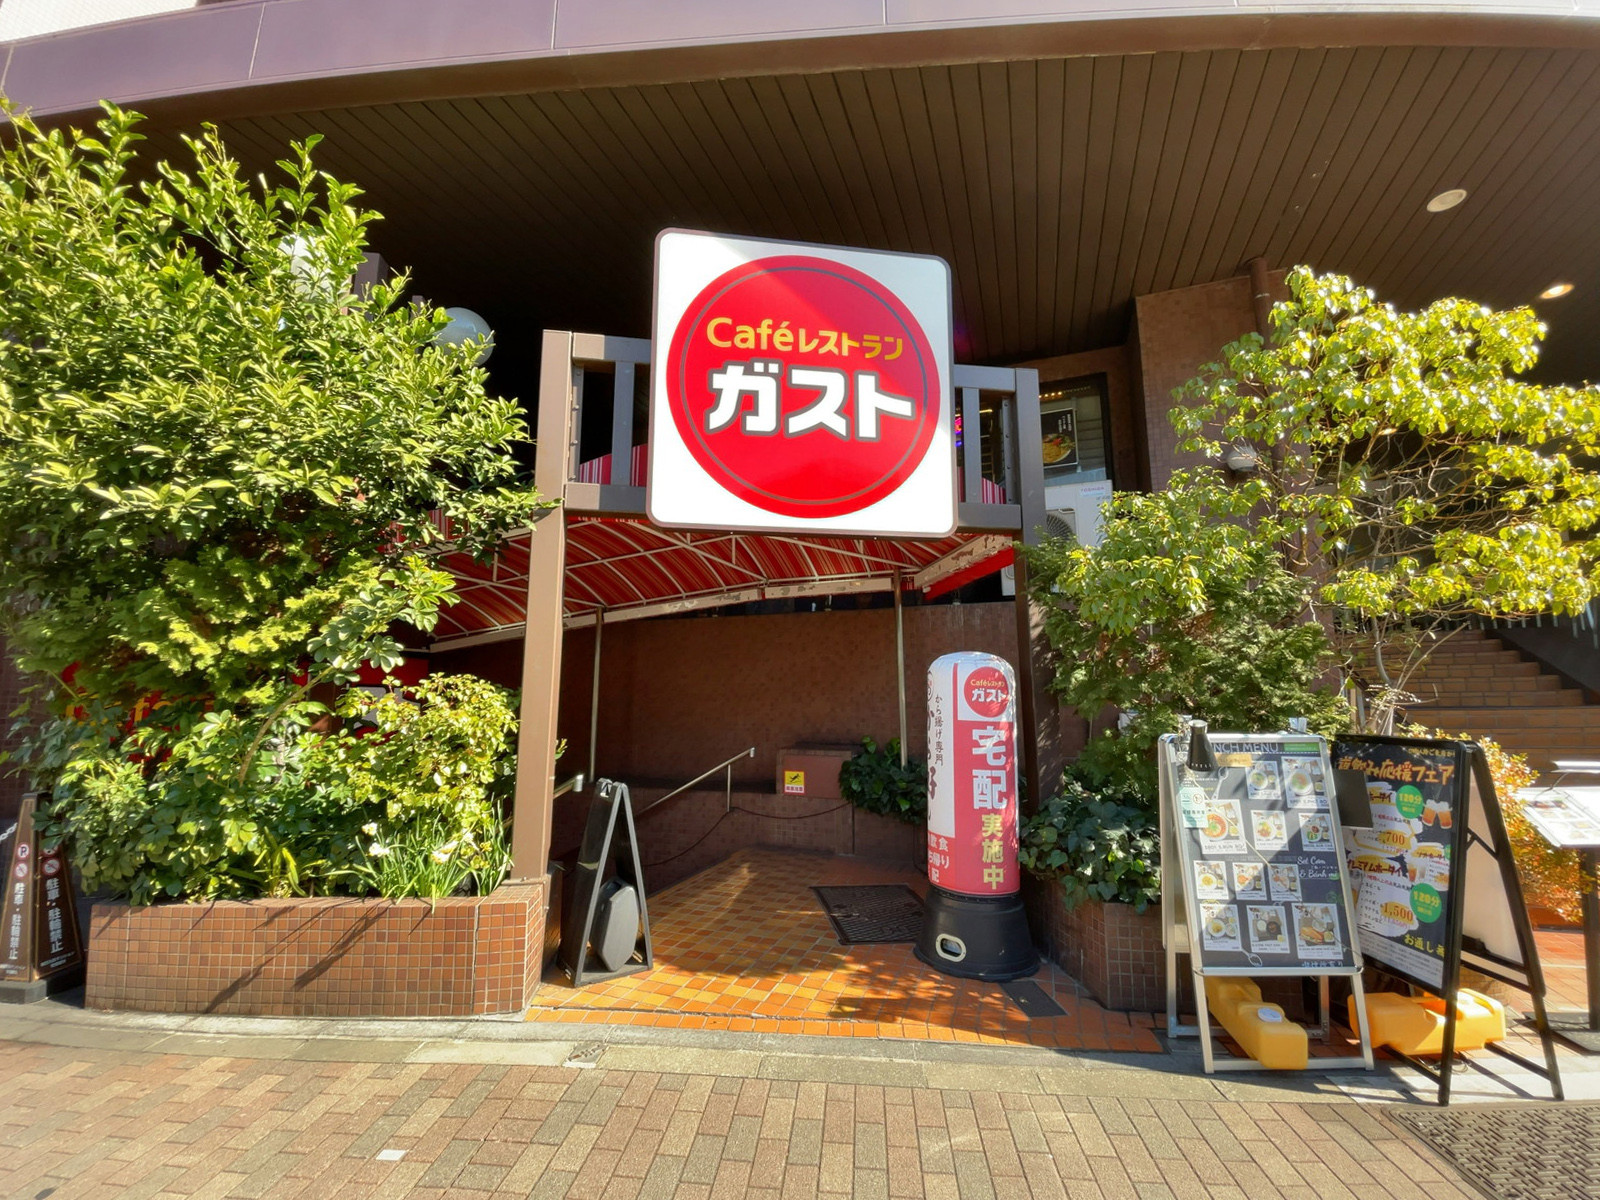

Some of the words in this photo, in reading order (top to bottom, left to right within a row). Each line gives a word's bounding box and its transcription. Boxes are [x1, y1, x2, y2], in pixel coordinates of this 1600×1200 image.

[705, 359, 914, 441] ガスト
[934, 694, 945, 766] から揚げ専門
[971, 688, 1007, 703] ガスト
[971, 725, 1008, 810] 宅配
[1242, 742, 1279, 753] MENU
[981, 813, 1006, 890] 実施中
[1386, 832, 1406, 846] 700
[8, 882, 26, 960] 駐車・駐輪禁止
[45, 877, 64, 954] 駐車・駐輪禁止
[1384, 902, 1414, 922] 1,500
